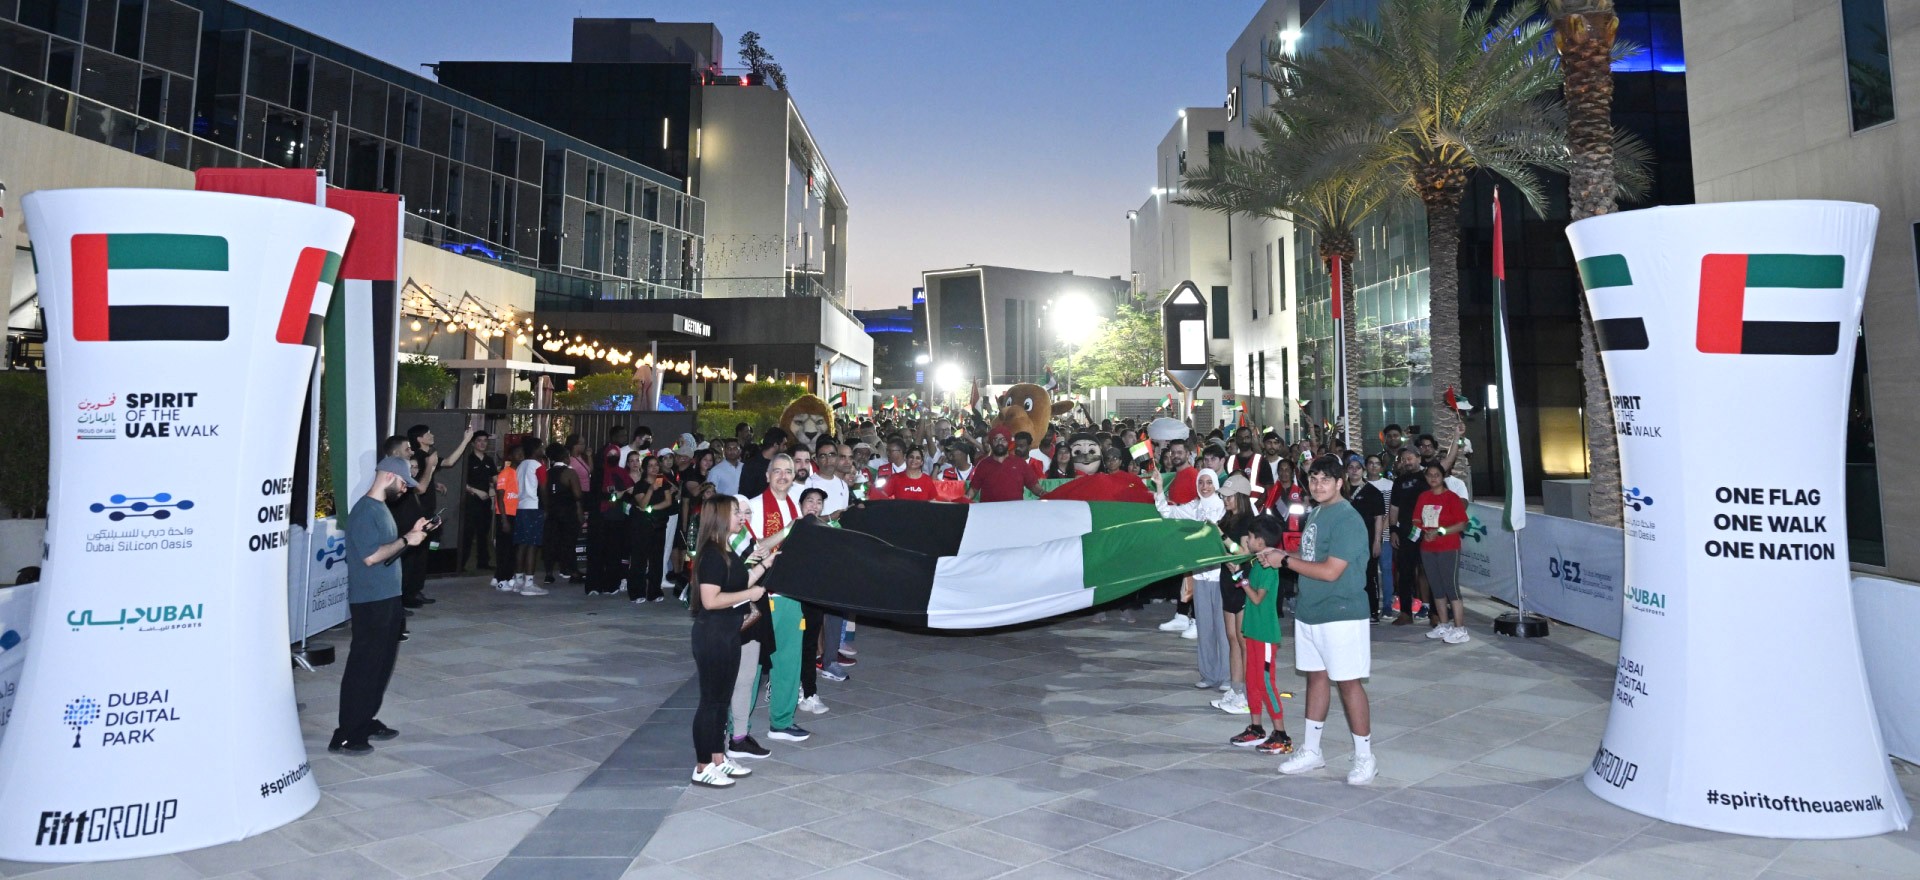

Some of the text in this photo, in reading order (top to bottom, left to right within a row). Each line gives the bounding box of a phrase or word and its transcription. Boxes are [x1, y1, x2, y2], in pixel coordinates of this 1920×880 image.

[77, 392, 116, 411] فخورين
[126, 392, 198, 408] SPIRIT
[125, 409, 180, 421] OF THE
[1621, 410, 1635, 421] THE
[125, 422, 219, 438] UAE WALK
[1633, 425, 1662, 438] WALK
[262, 478, 287, 496] ONE
[1715, 486, 1821, 506] ONE FLAG
[258, 504, 284, 524] ONE
[1713, 513, 1827, 533] ONE WALK
[141, 528, 165, 540] دبي
[168, 526, 194, 537] واحة
[85, 539, 193, 553] Dubai Silicon Oasis
[249, 532, 279, 552] ONE
[1704, 540, 1835, 561] ONE NATION
[171, 622, 203, 630] SPORTS
[108, 689, 169, 708] DUBAI
[105, 707, 181, 727] DIGITAL
[102, 728, 156, 747] PARK
[1707, 789, 1885, 813] #spiritoftheuaewalk
